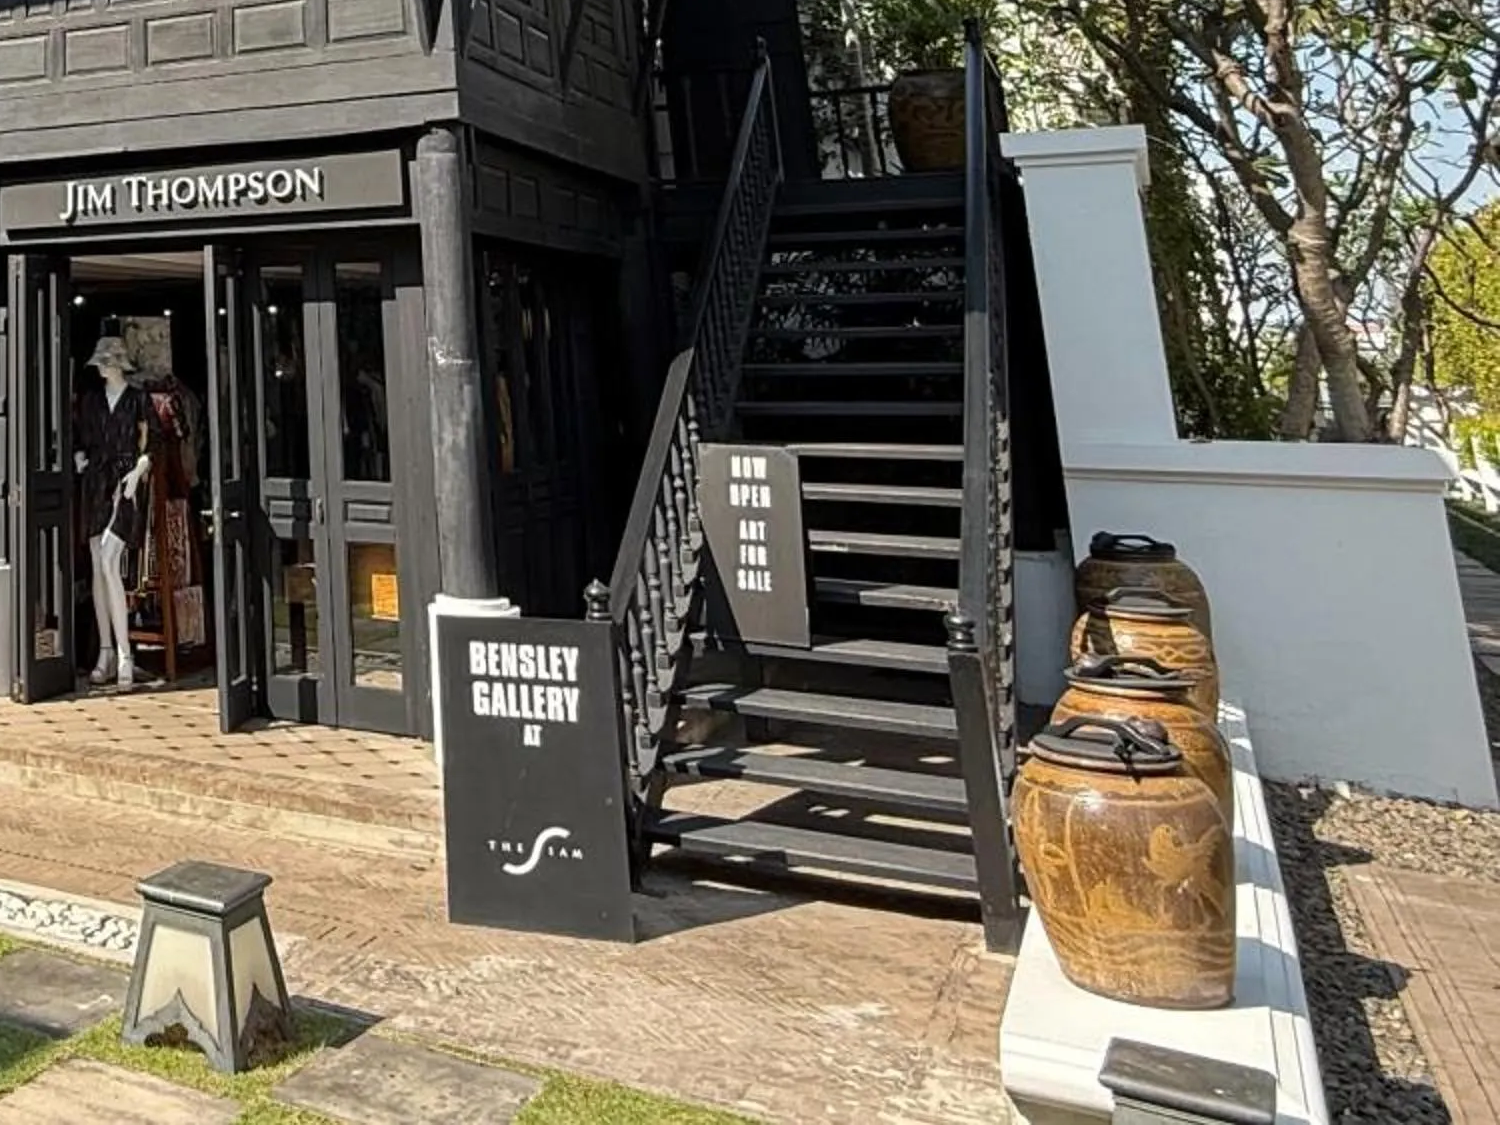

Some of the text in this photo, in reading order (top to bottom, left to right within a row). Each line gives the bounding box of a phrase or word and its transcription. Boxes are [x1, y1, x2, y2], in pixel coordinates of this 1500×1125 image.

[59, 167, 319, 220] JIM THOMPSON
[729, 484, 771, 508] OPEN
[739, 520, 766, 541] ART
[737, 569, 772, 592] SALE
[469, 640, 579, 682] BENSLEY
[472, 678, 580, 723] GALLERY
[523, 724, 543, 747] AT
[488, 839, 524, 854] THE
